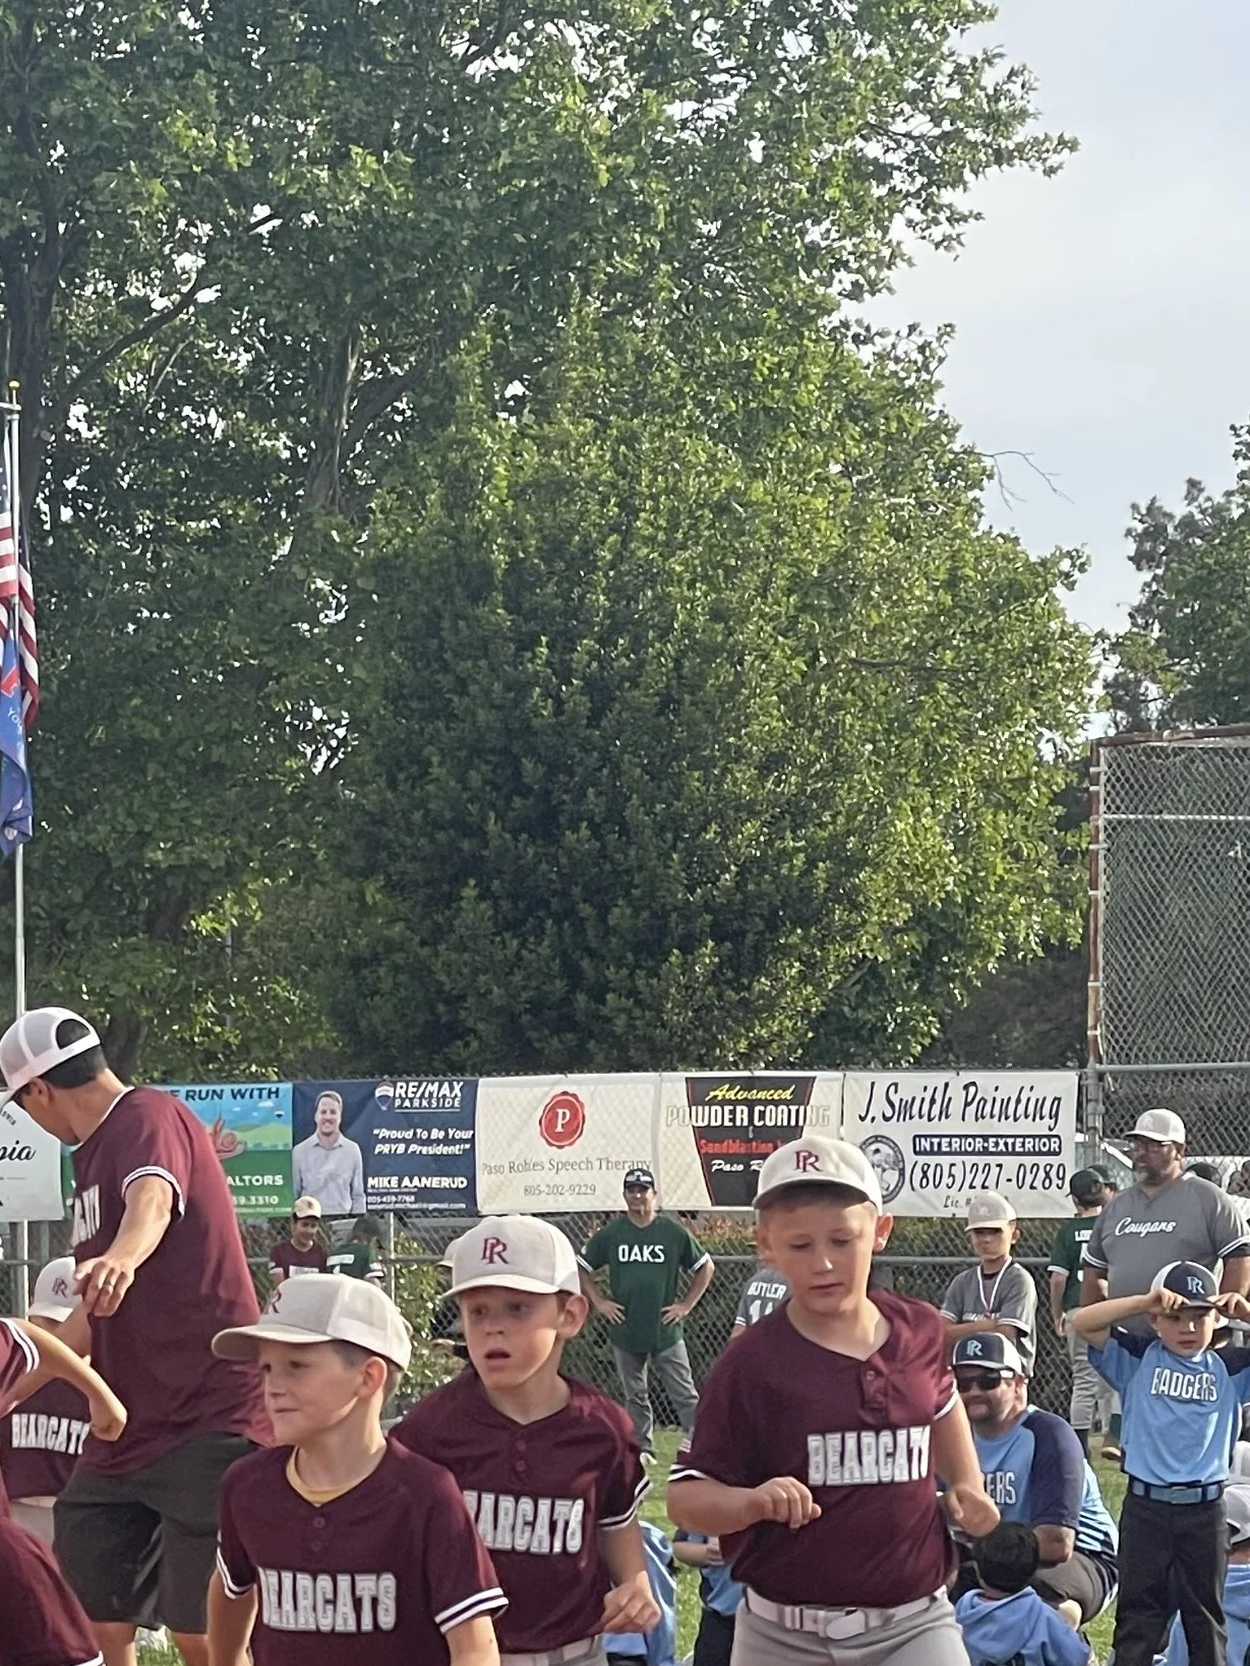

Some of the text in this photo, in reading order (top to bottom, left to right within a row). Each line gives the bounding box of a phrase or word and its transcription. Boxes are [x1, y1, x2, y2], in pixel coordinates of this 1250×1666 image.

[185, 1088, 225, 1101] RUN
[230, 1087, 280, 1100] WITH
[395, 1081, 464, 1098] RE/MAX
[705, 1084, 796, 1101] Advanced
[394, 1098, 461, 1108] PARKSIDE
[961, 1081, 1063, 1132] Painting
[554, 1108, 571, 1132] P
[667, 1105, 831, 1128] POWDER COATING
[416, 1129, 428, 1139] To
[430, 1128, 445, 1139] Be
[448, 1128, 474, 1139] Your
[374, 1144, 406, 1155] PRYB
[482, 1157, 652, 1175] Paso Robles Speech Therapy
[711, 1160, 744, 1172] Paso
[226, 1175, 284, 1186] ALTORS
[367, 1176, 468, 1189] MIKE AANERUD
[909, 1161, 1067, 1192] (805)227-0289
[524, 1184, 596, 1196] 805-202-9229
[1115, 1216, 1177, 1238] Cougars
[618, 1244, 665, 1264] OAKS
[747, 1281, 787, 1299] BUTLER
[1151, 1367, 1218, 1401] BADGERS
